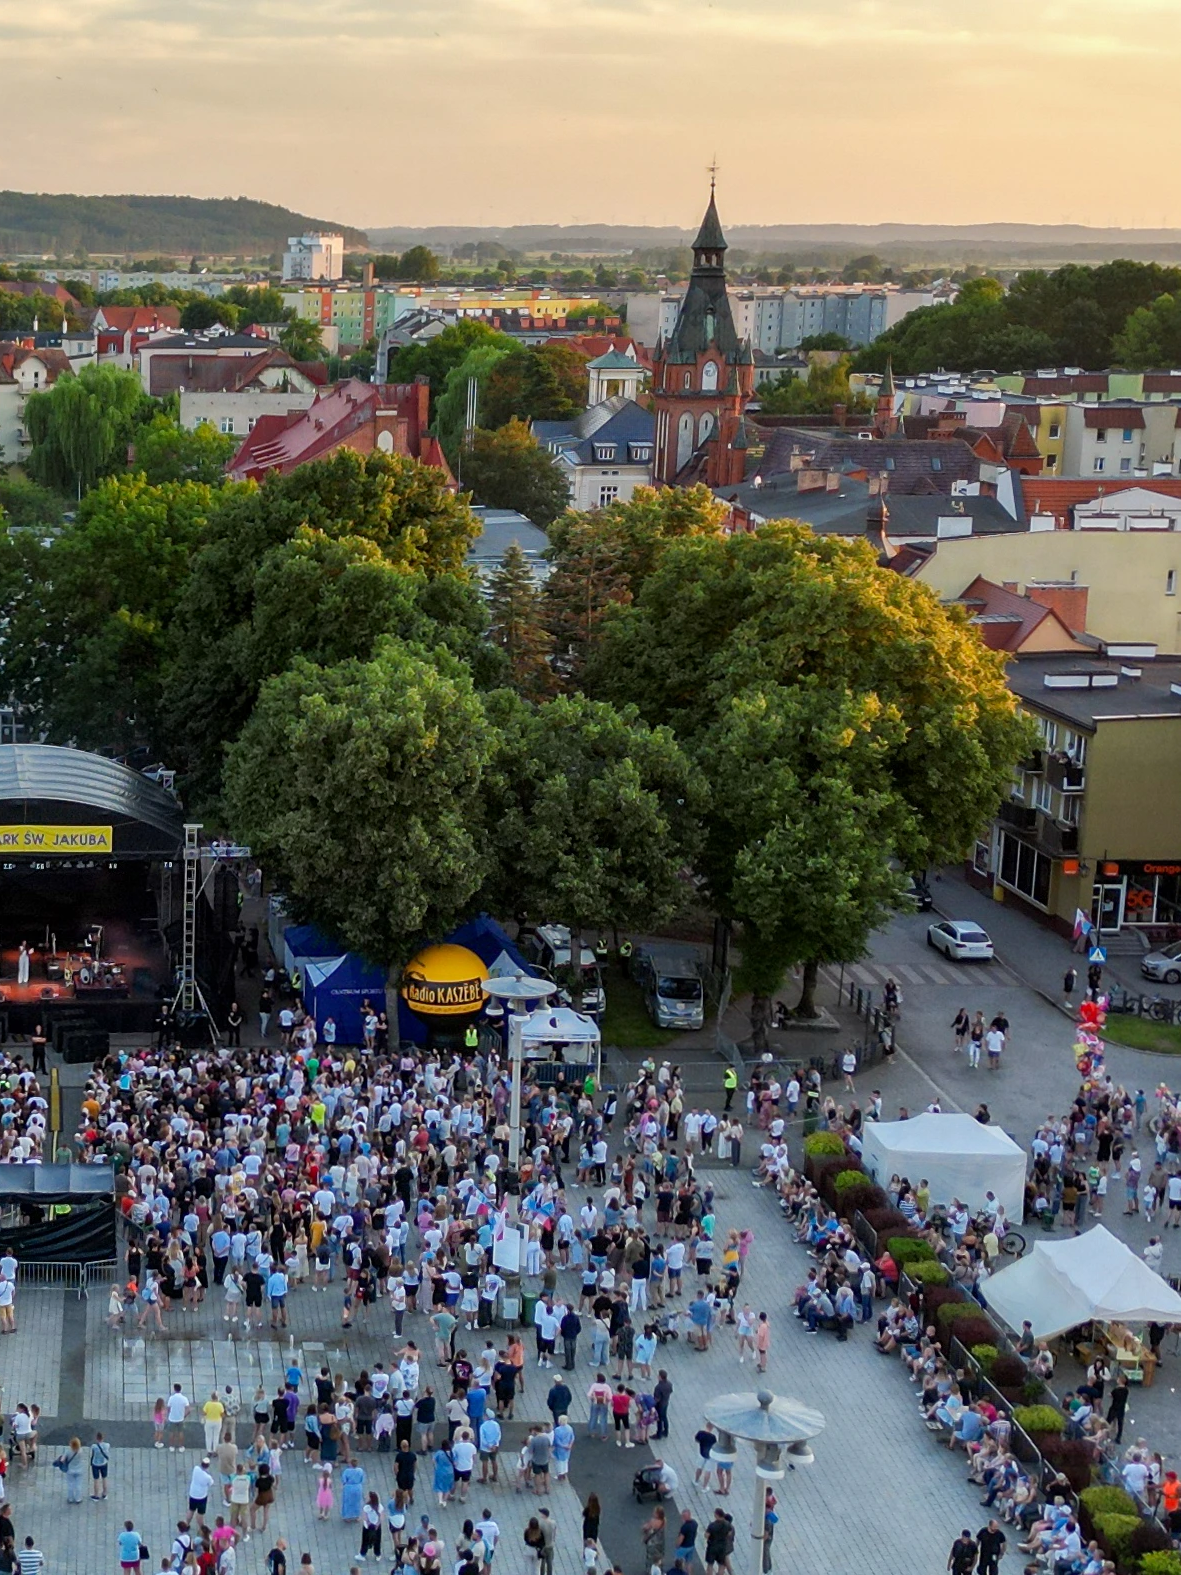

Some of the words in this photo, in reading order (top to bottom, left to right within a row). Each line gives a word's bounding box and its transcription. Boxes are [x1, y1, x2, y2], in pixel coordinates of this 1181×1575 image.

[23, 830, 48, 846] ŚW.
[52, 833, 108, 846] JAKUBA
[1143, 863, 1181, 876] Orange
[1127, 889, 1154, 908] 5G
[409, 983, 436, 1003] Radio
